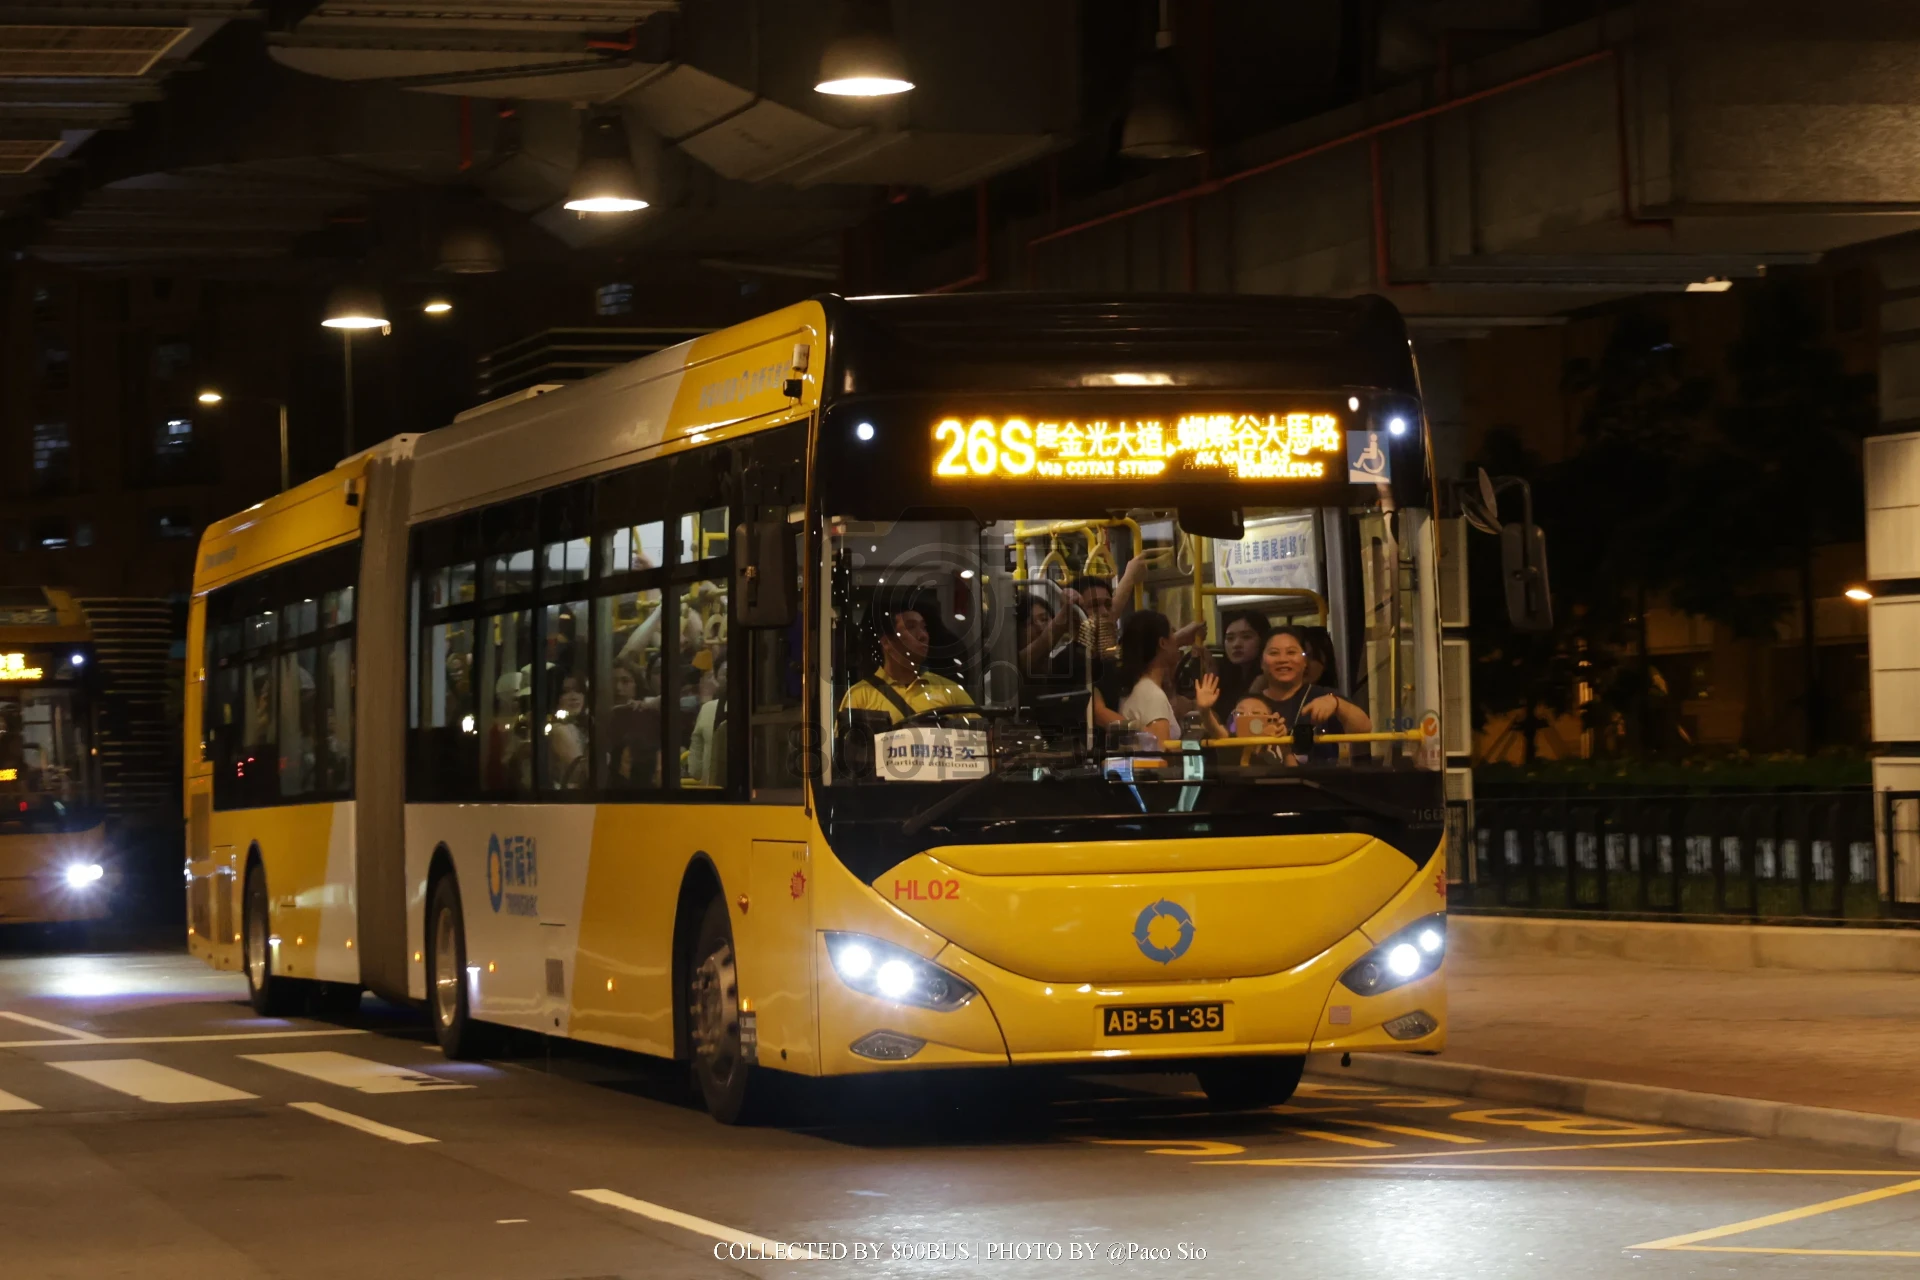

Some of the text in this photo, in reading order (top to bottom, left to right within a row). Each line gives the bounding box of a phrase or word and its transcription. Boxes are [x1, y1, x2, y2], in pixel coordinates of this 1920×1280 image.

[936, 418, 1036, 476] 26S
[1066, 460, 1115, 476] COTAI
[1118, 460, 1166, 476] STRIP
[887, 744, 977, 761] 加開班次
[886, 758, 978, 769] Partida adicional
[894, 879, 960, 900] HL02
[1107, 1006, 1220, 1033] AB-51-35
